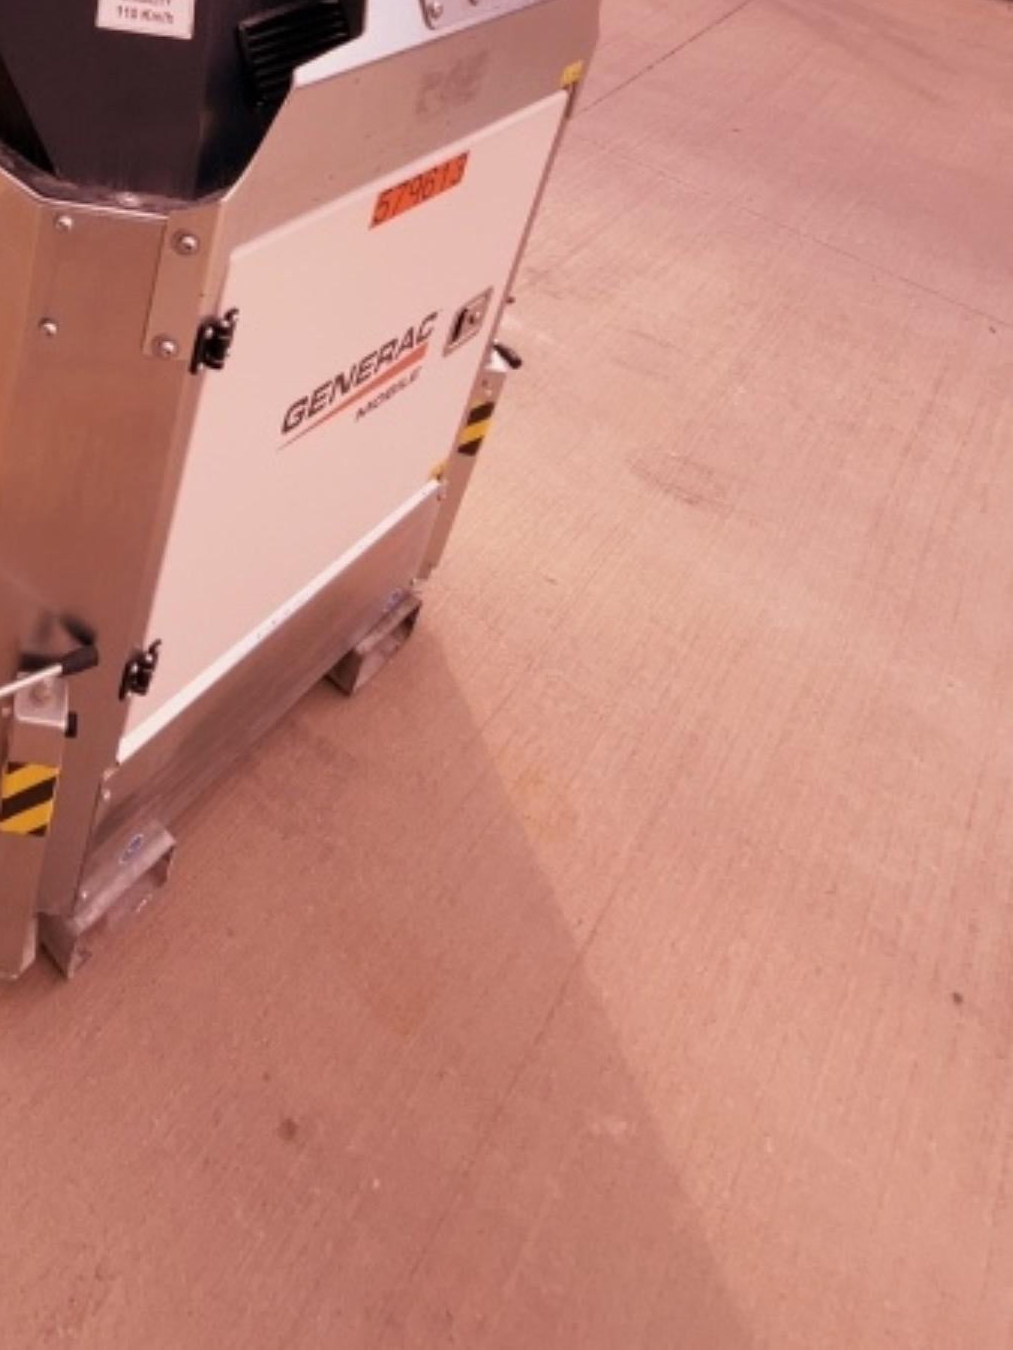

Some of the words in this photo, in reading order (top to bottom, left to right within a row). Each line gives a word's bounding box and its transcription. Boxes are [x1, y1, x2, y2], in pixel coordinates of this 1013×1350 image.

[371, 152, 468, 227] 579613
[281, 311, 438, 434] GENERAC
[354, 365, 422, 423] MOBILE
